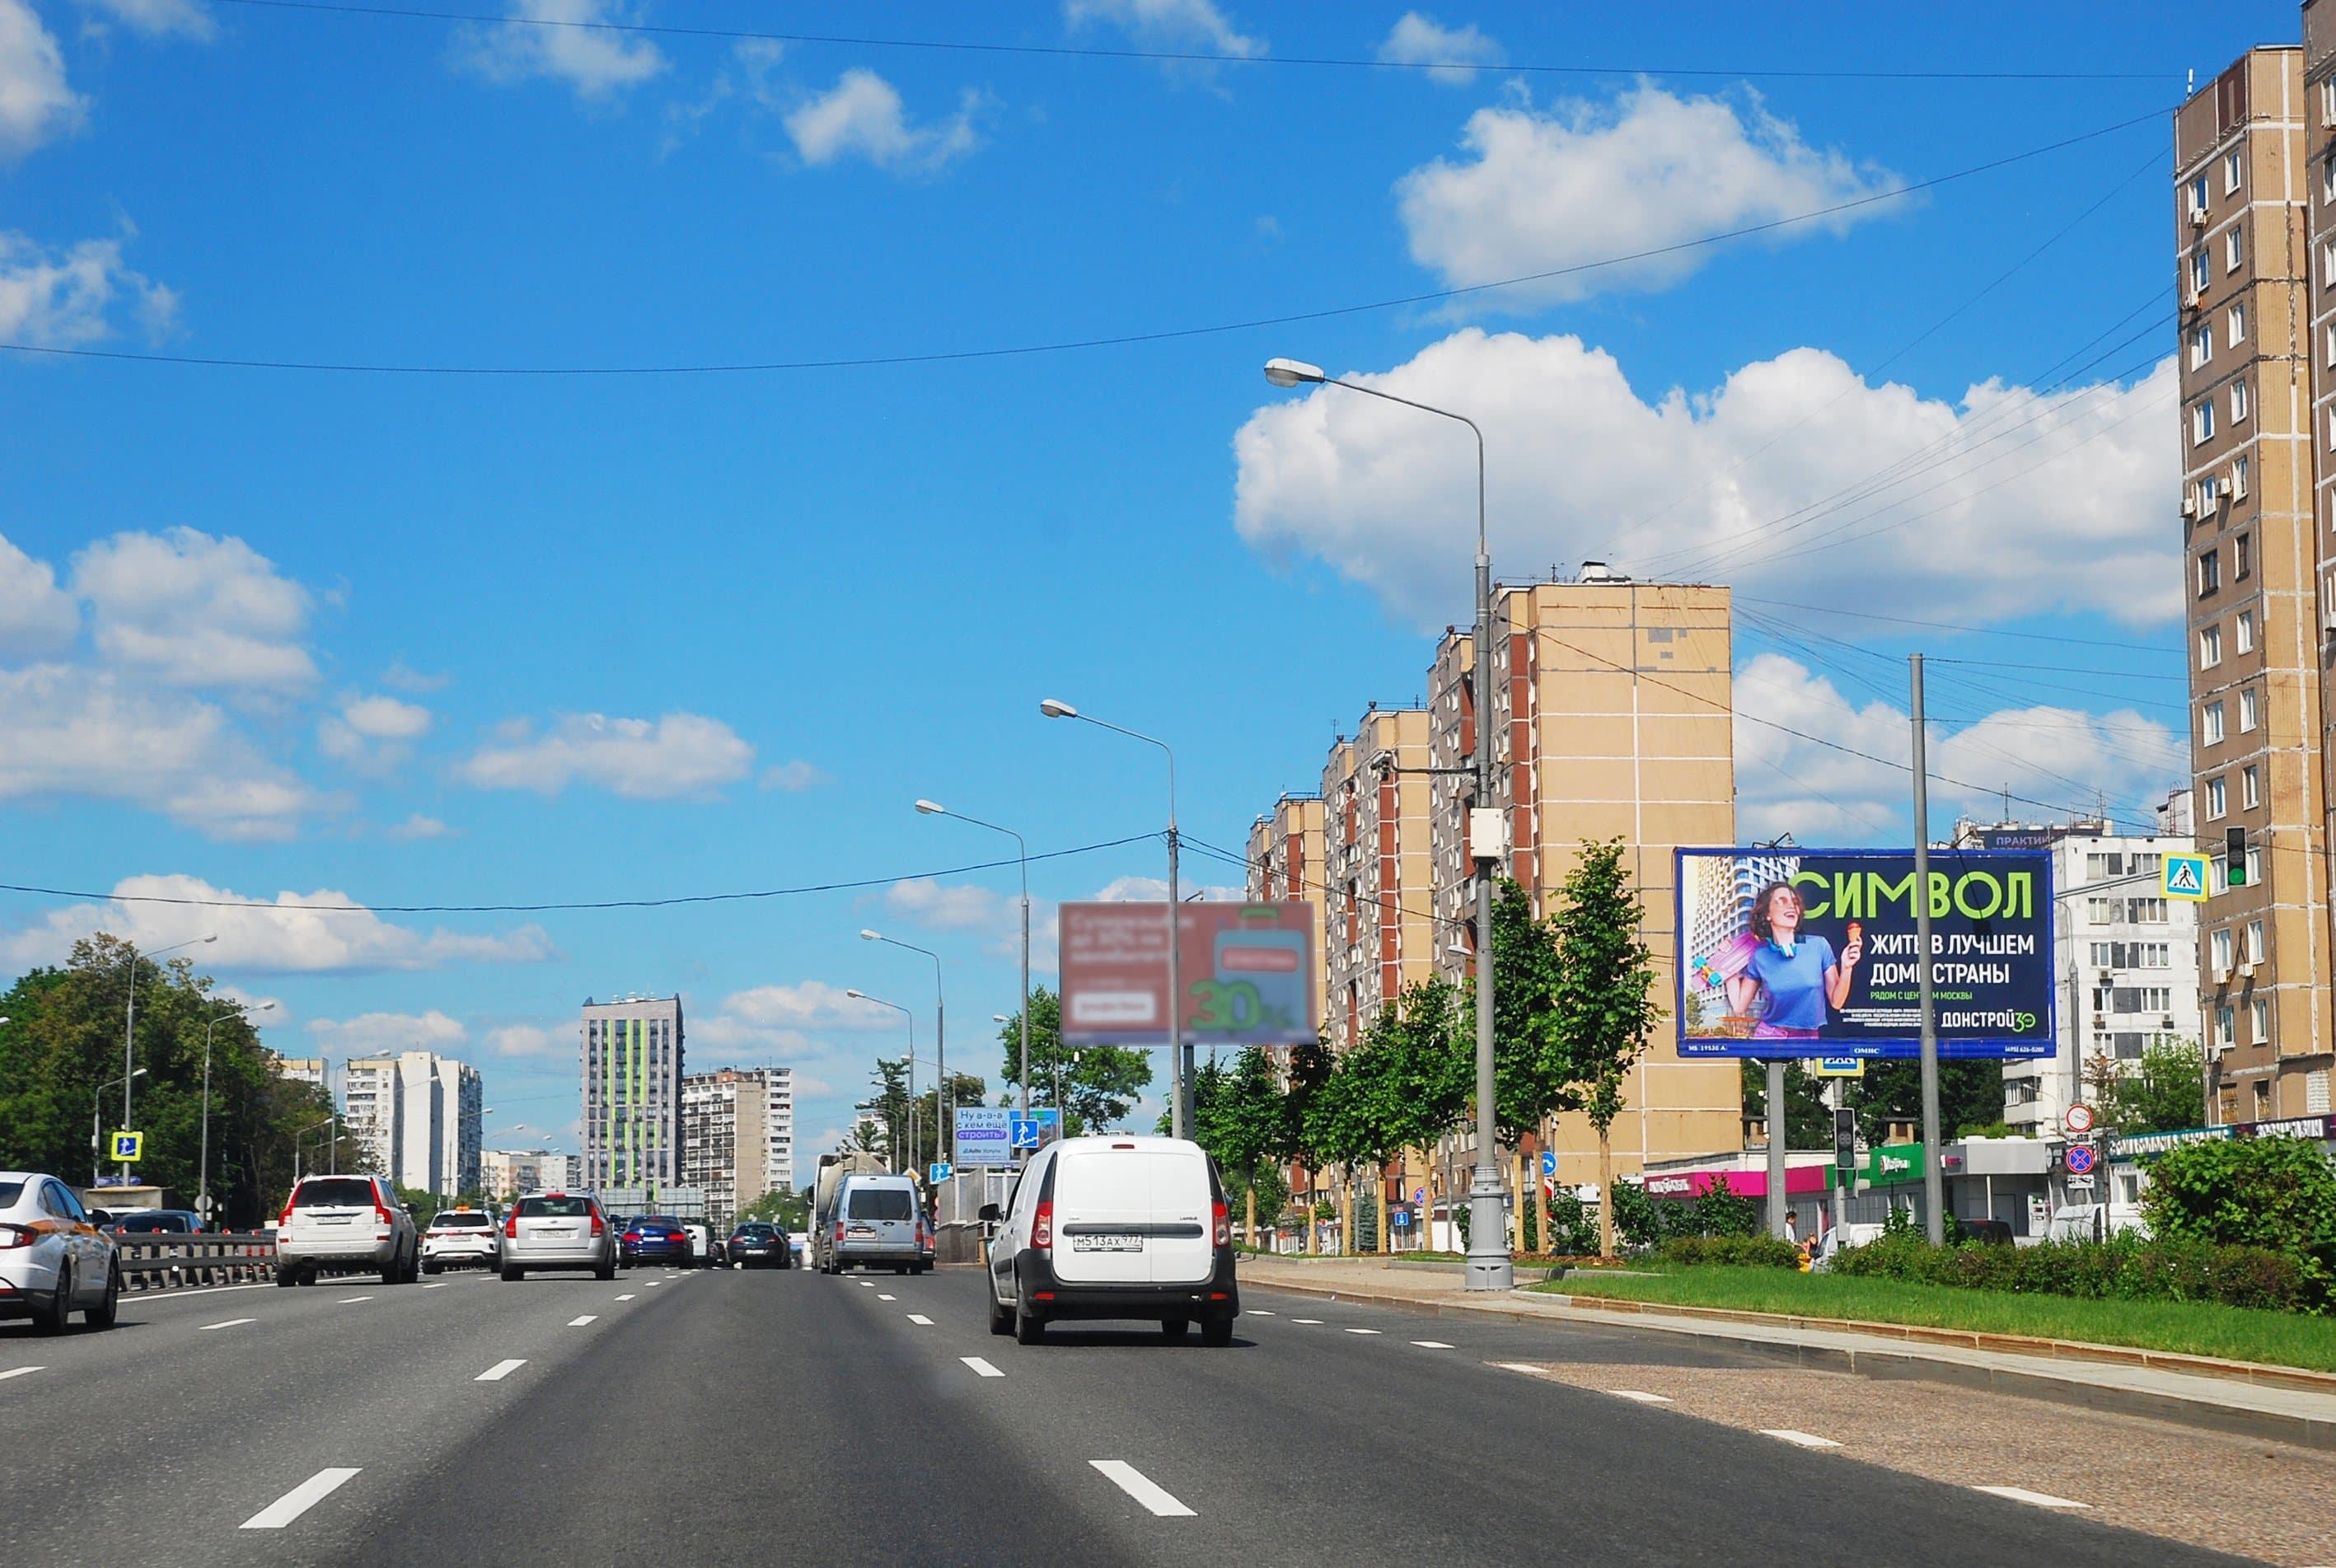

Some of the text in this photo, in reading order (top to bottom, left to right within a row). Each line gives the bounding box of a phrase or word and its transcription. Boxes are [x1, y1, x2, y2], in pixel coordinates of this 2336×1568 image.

[1789, 871, 2032, 920] СИМВОЛ
[1931, 934, 1944, 955] В
[1947, 934, 2034, 955] ЛУЧШЕМ
[1870, 962, 2010, 986] ДОМ СТРАНЫ
[1870, 991, 1897, 1000] РЯДОМ
[1898, 991, 1903, 1000] С
[1940, 991, 1973, 1000] МОСКВЫ
[1940, 1009, 2015, 1027] ДОНСТРОЙ
